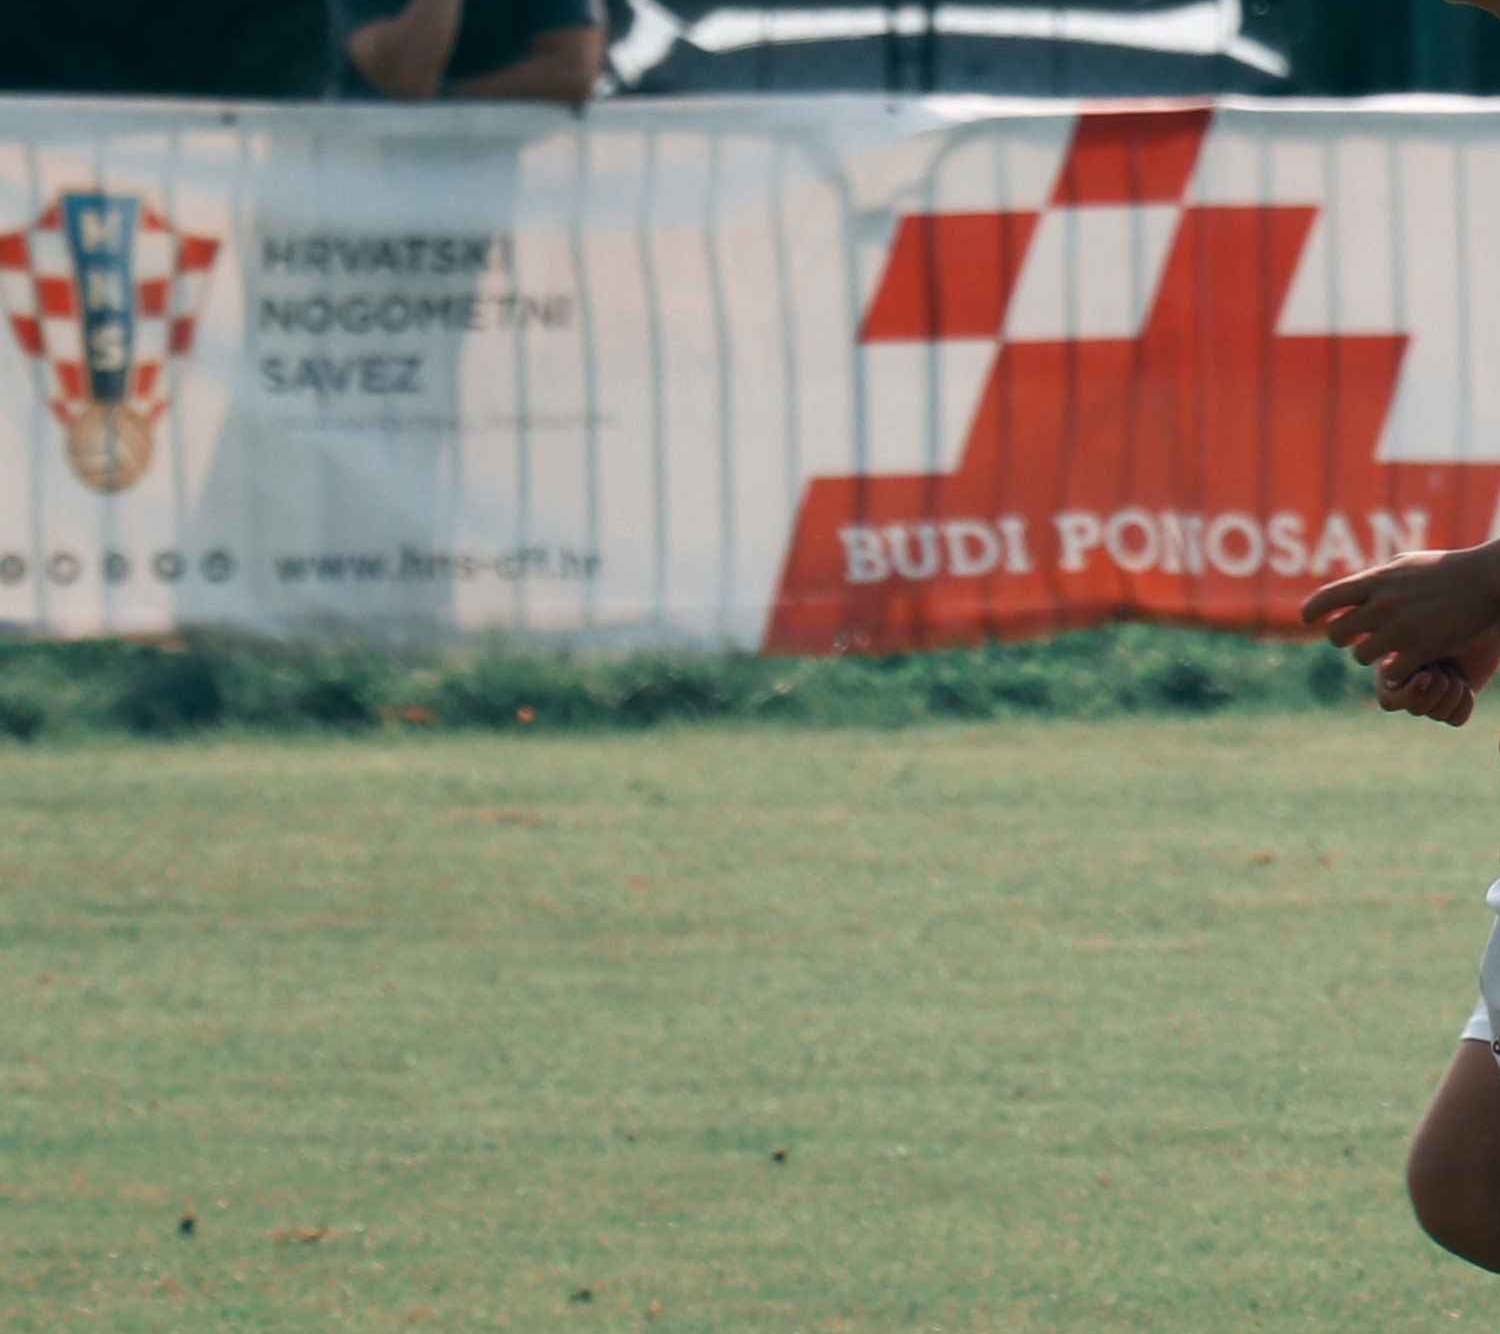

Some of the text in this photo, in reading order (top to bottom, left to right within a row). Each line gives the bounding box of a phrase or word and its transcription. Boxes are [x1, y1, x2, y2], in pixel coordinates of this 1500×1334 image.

[259, 233, 514, 273] HRVATSKI
[258, 294, 573, 335] NOGOMETNI
[259, 356, 423, 395] SAVEZ
[838, 505, 1432, 584] BUDI PONOSAN
